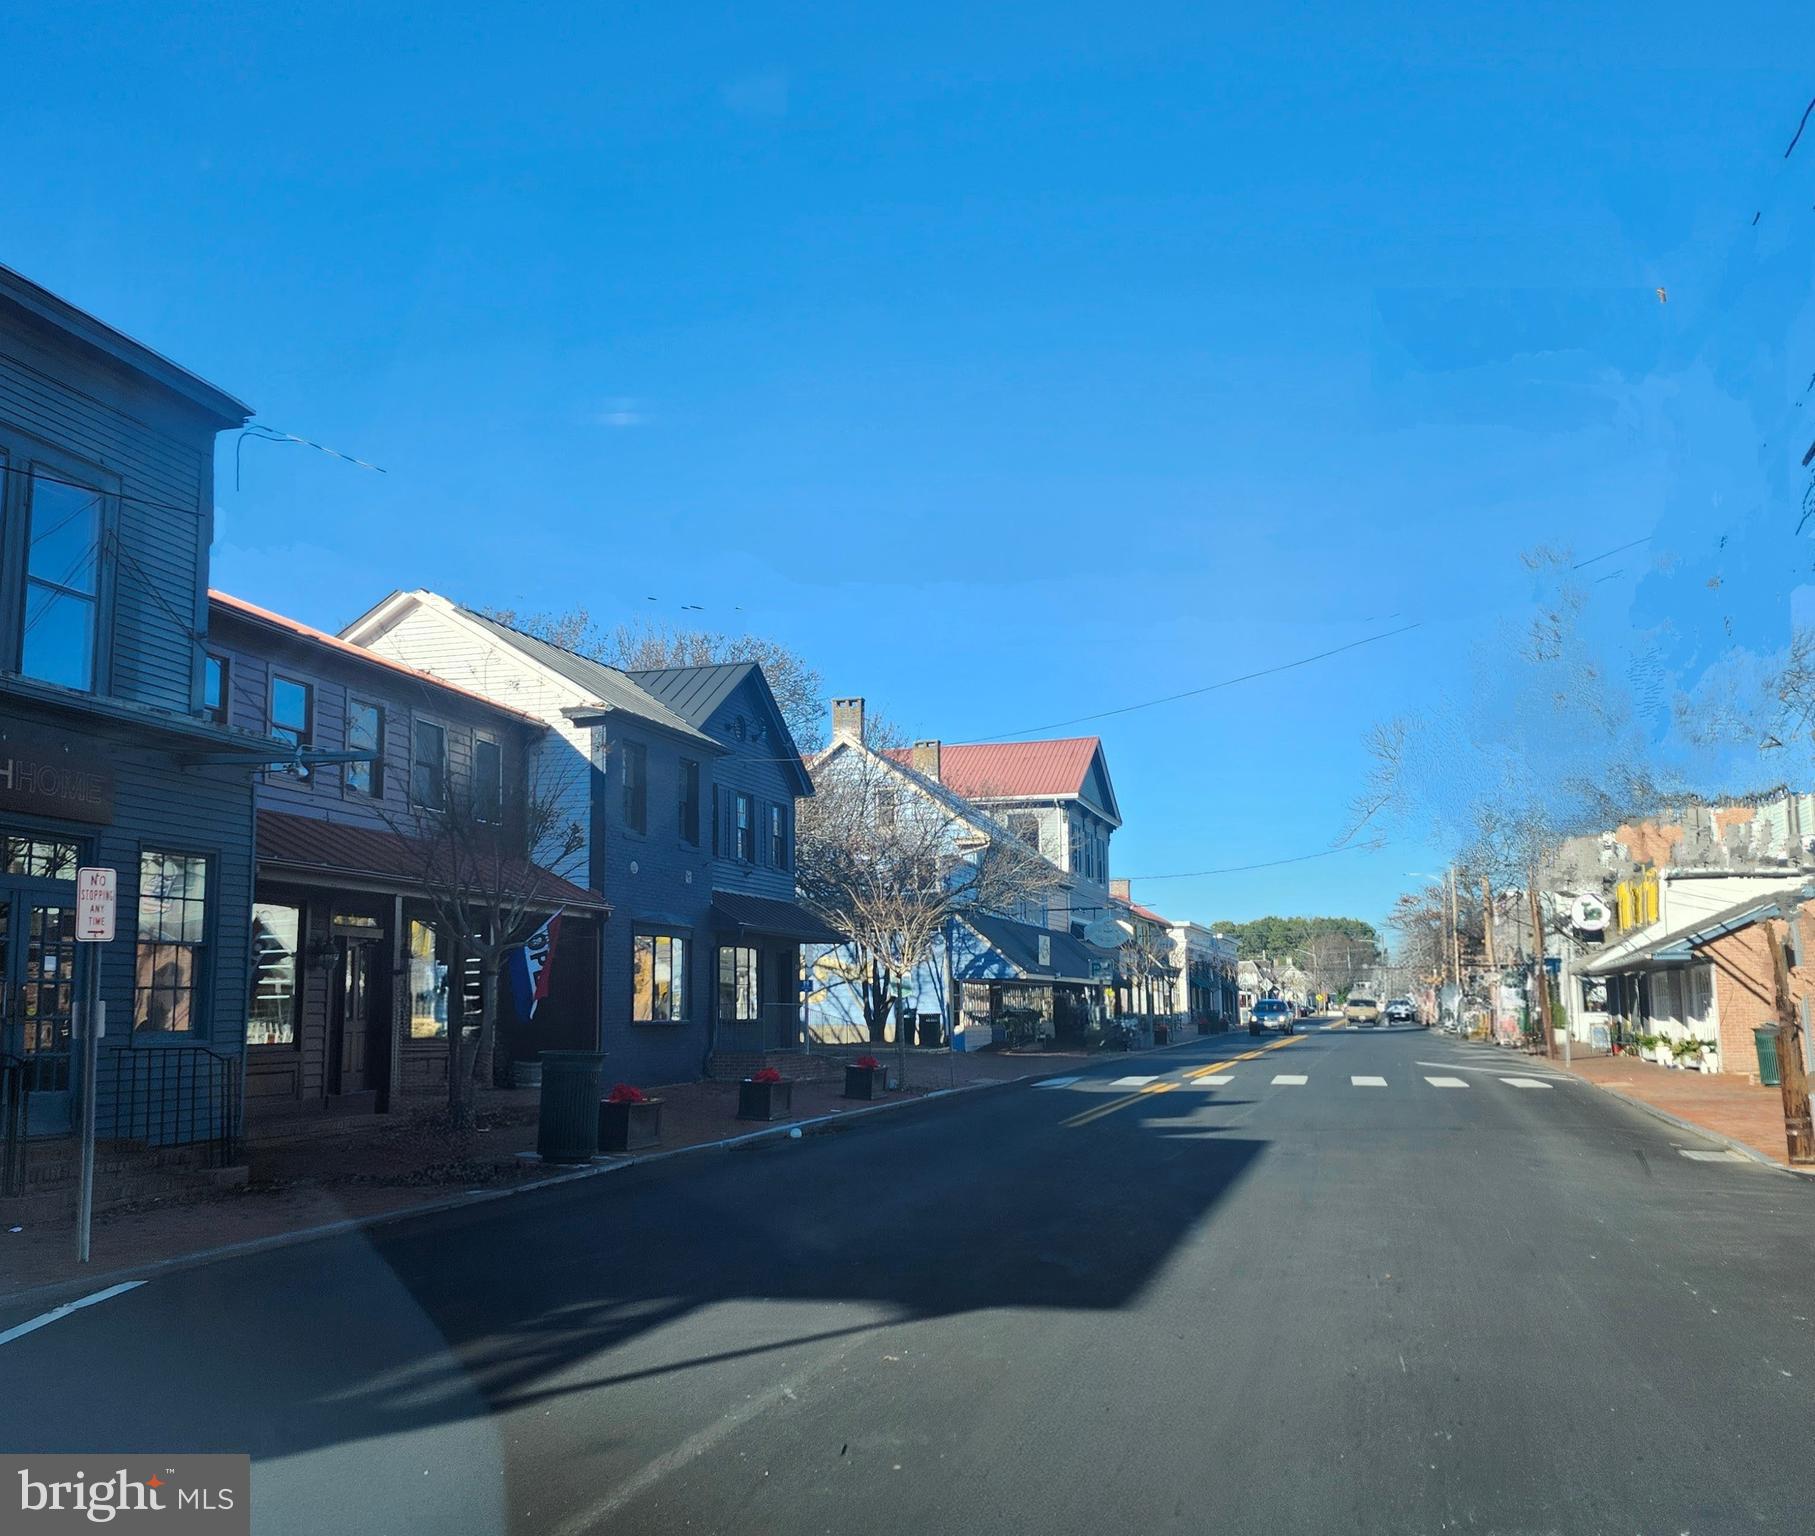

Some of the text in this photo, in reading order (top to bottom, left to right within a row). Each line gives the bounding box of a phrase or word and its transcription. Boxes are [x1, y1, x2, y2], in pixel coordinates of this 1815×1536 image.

[90, 874, 106, 887] NO
[90, 904, 105, 914] ANY
[89, 916, 105, 926] TIME
